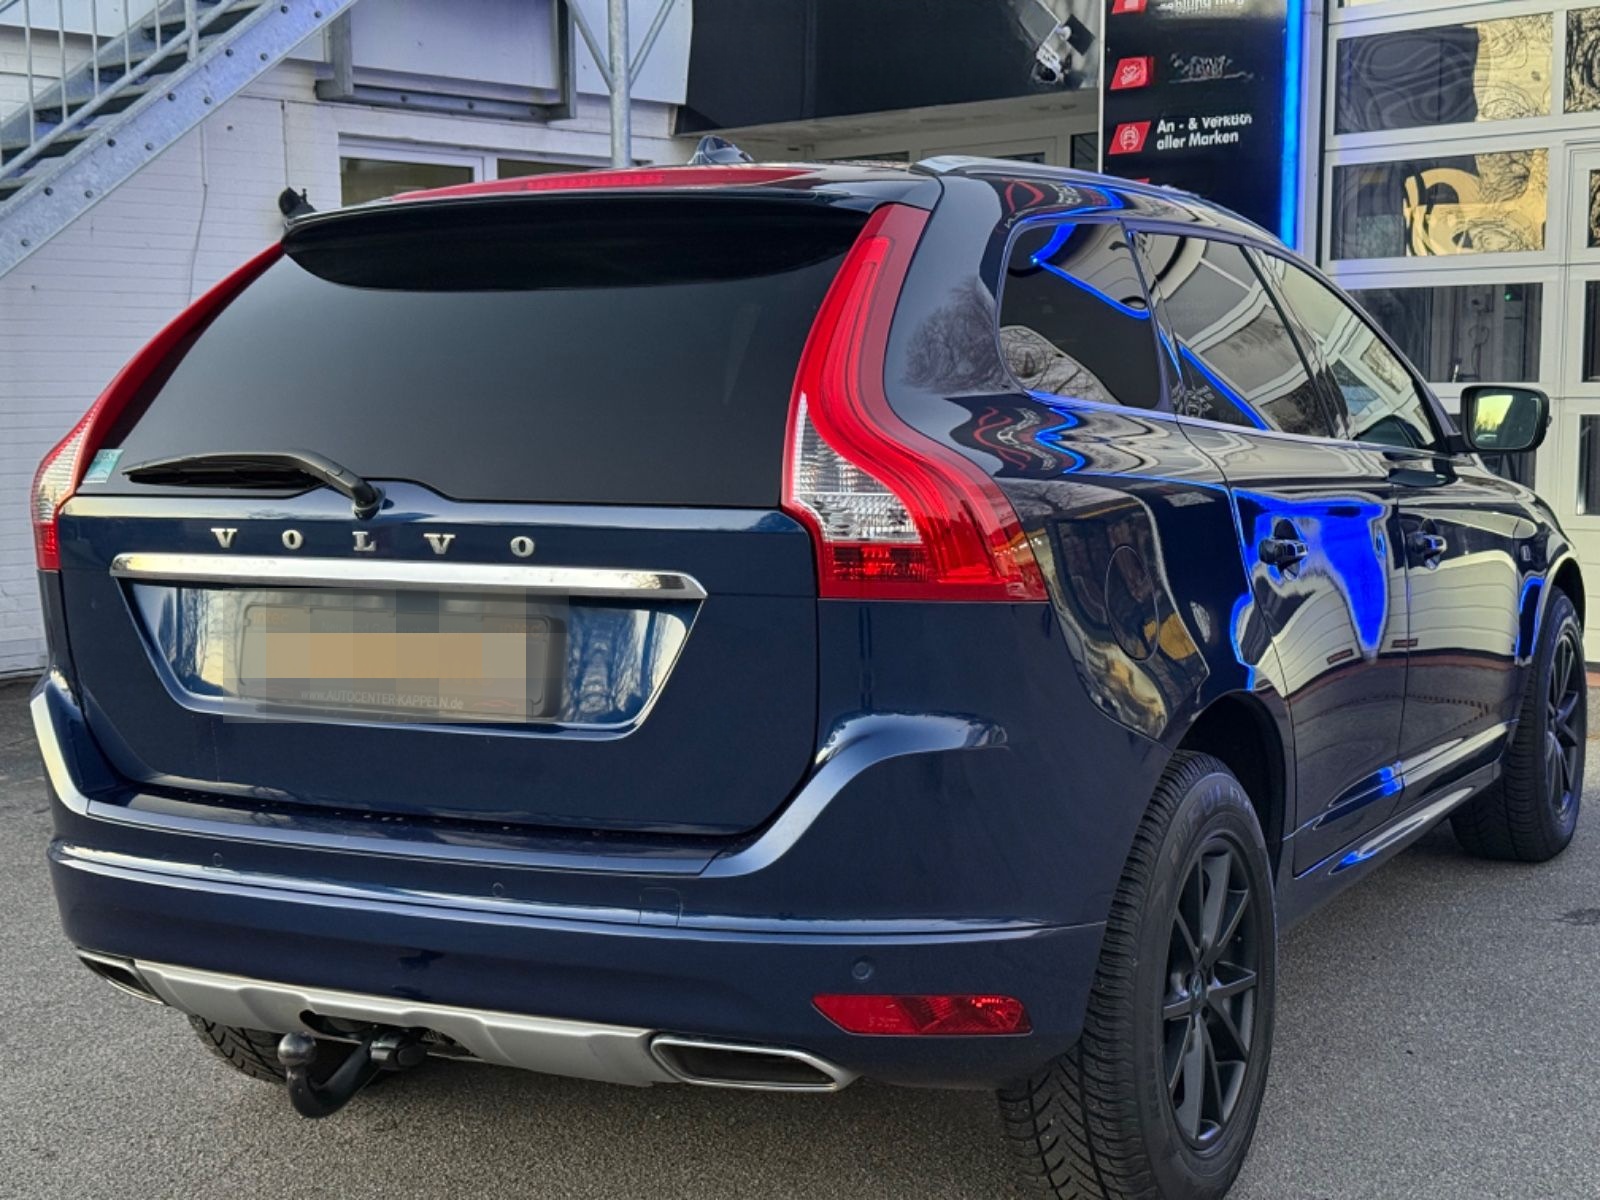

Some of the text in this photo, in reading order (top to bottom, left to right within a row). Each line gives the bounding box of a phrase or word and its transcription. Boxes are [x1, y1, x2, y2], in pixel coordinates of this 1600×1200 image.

[1157, 119, 1175, 134] An
[1188, 117, 1198, 131] &
[1156, 130, 1239, 150] aller Marken
[210, 527, 536, 558] VOLVO
